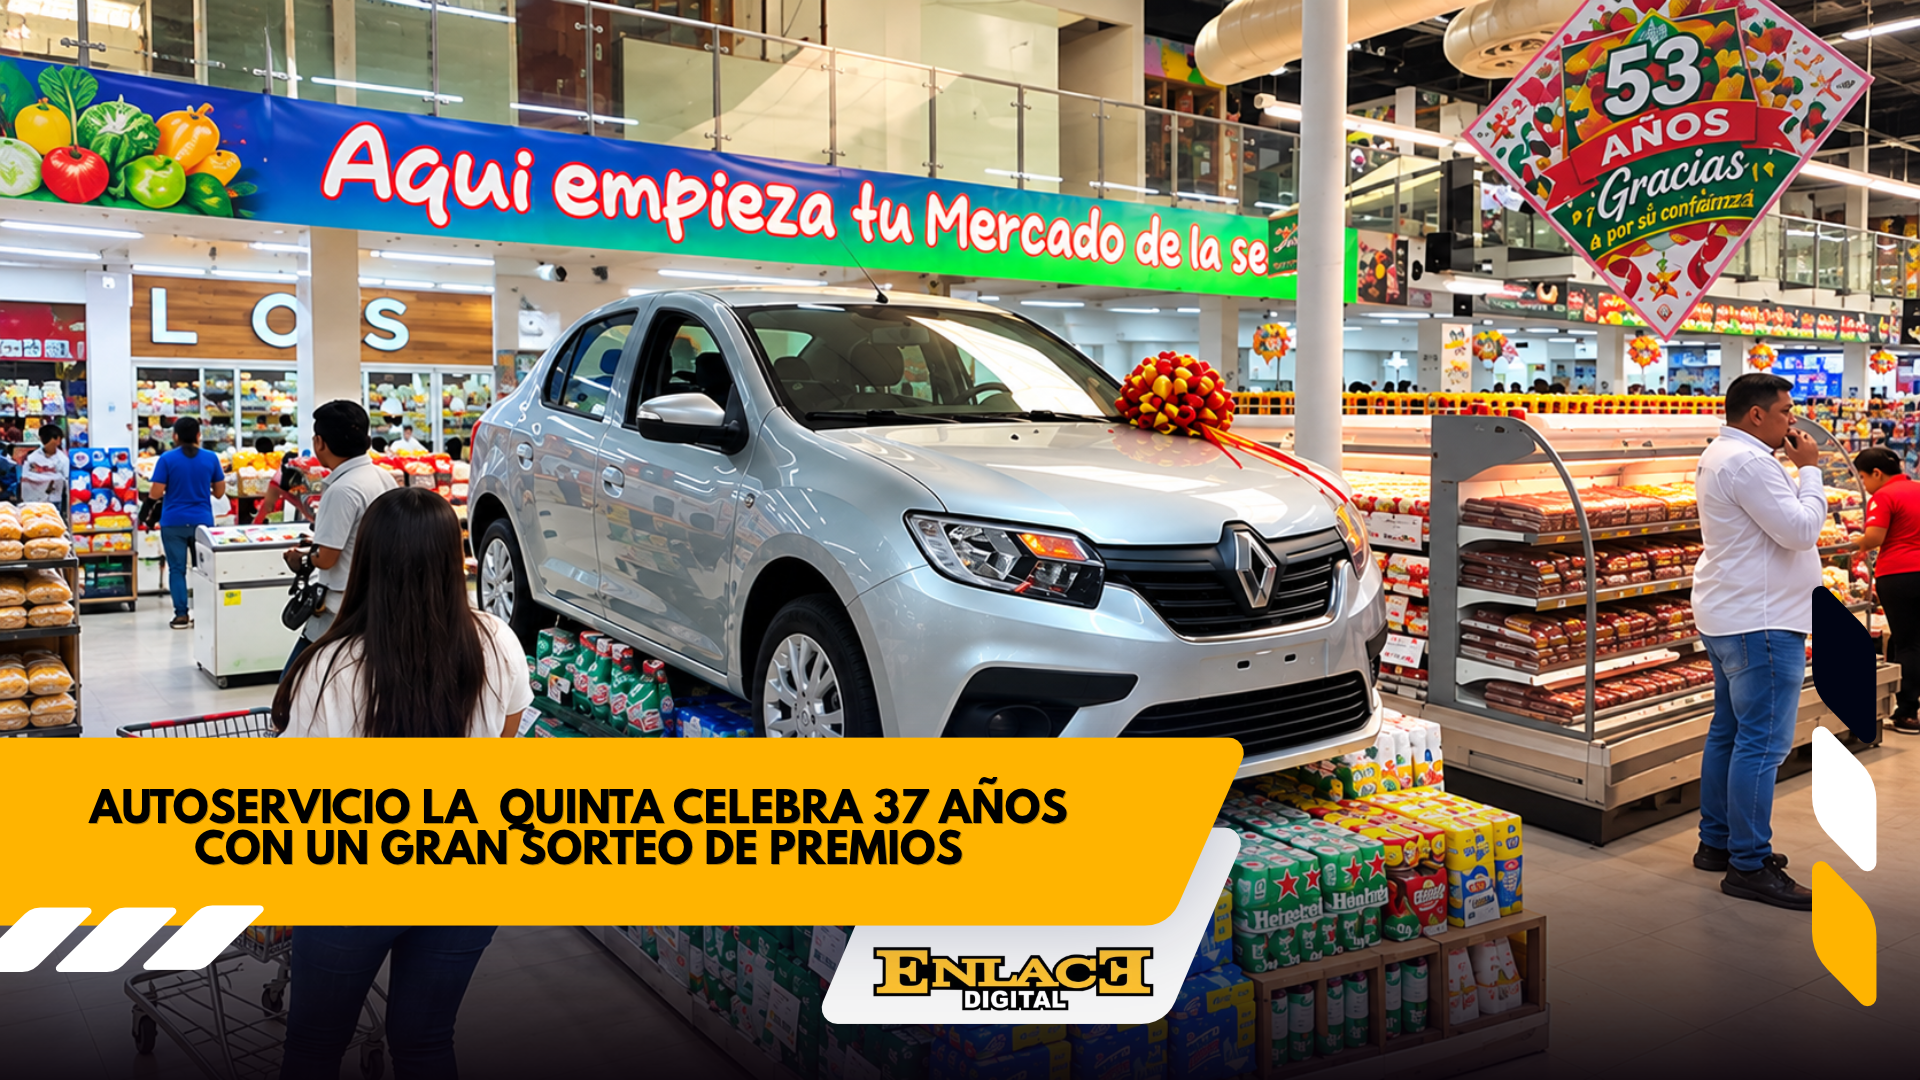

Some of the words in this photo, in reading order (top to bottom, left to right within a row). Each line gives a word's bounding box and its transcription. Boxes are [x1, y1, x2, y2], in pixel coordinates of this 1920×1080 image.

[1603, 35, 1702, 116] 53
[1601, 108, 1730, 167] AÑOS
[321, 122, 534, 228] Aqui
[552, 161, 837, 244] empieza
[851, 180, 915, 245] tu
[925, 191, 1126, 264] Mercado
[1134, 212, 1183, 269] de
[1189, 223, 1223, 273] la
[1230, 236, 1269, 276] se
[1607, 220, 1635, 247] por
